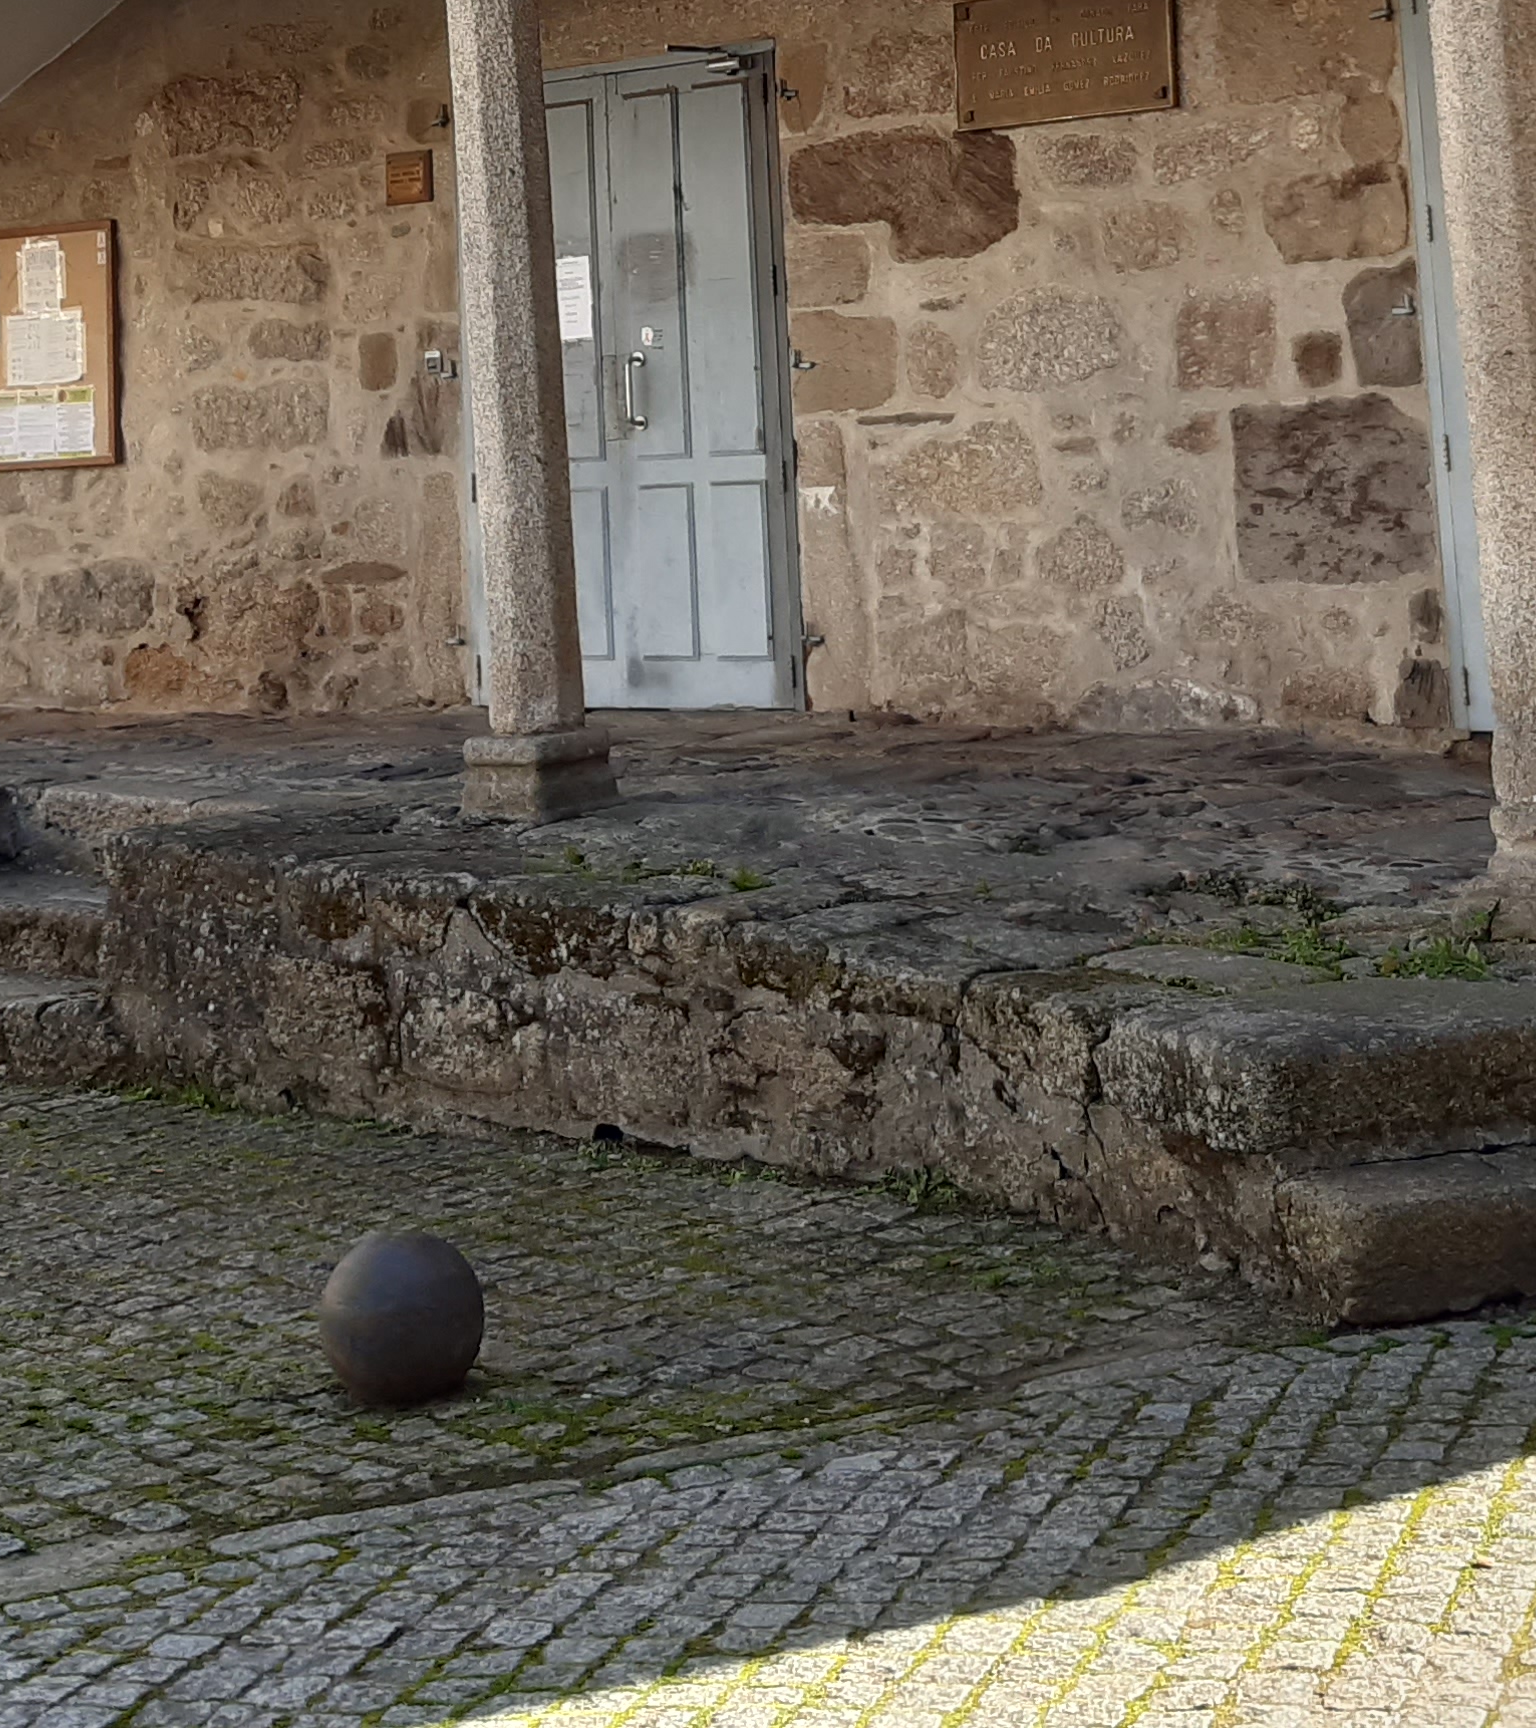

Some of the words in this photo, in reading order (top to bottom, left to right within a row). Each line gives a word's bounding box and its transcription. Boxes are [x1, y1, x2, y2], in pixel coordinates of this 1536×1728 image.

[980, 41, 1017, 60] CASA
[1035, 36, 1052, 53] DA
[1071, 25, 1135, 49] CULTURA
